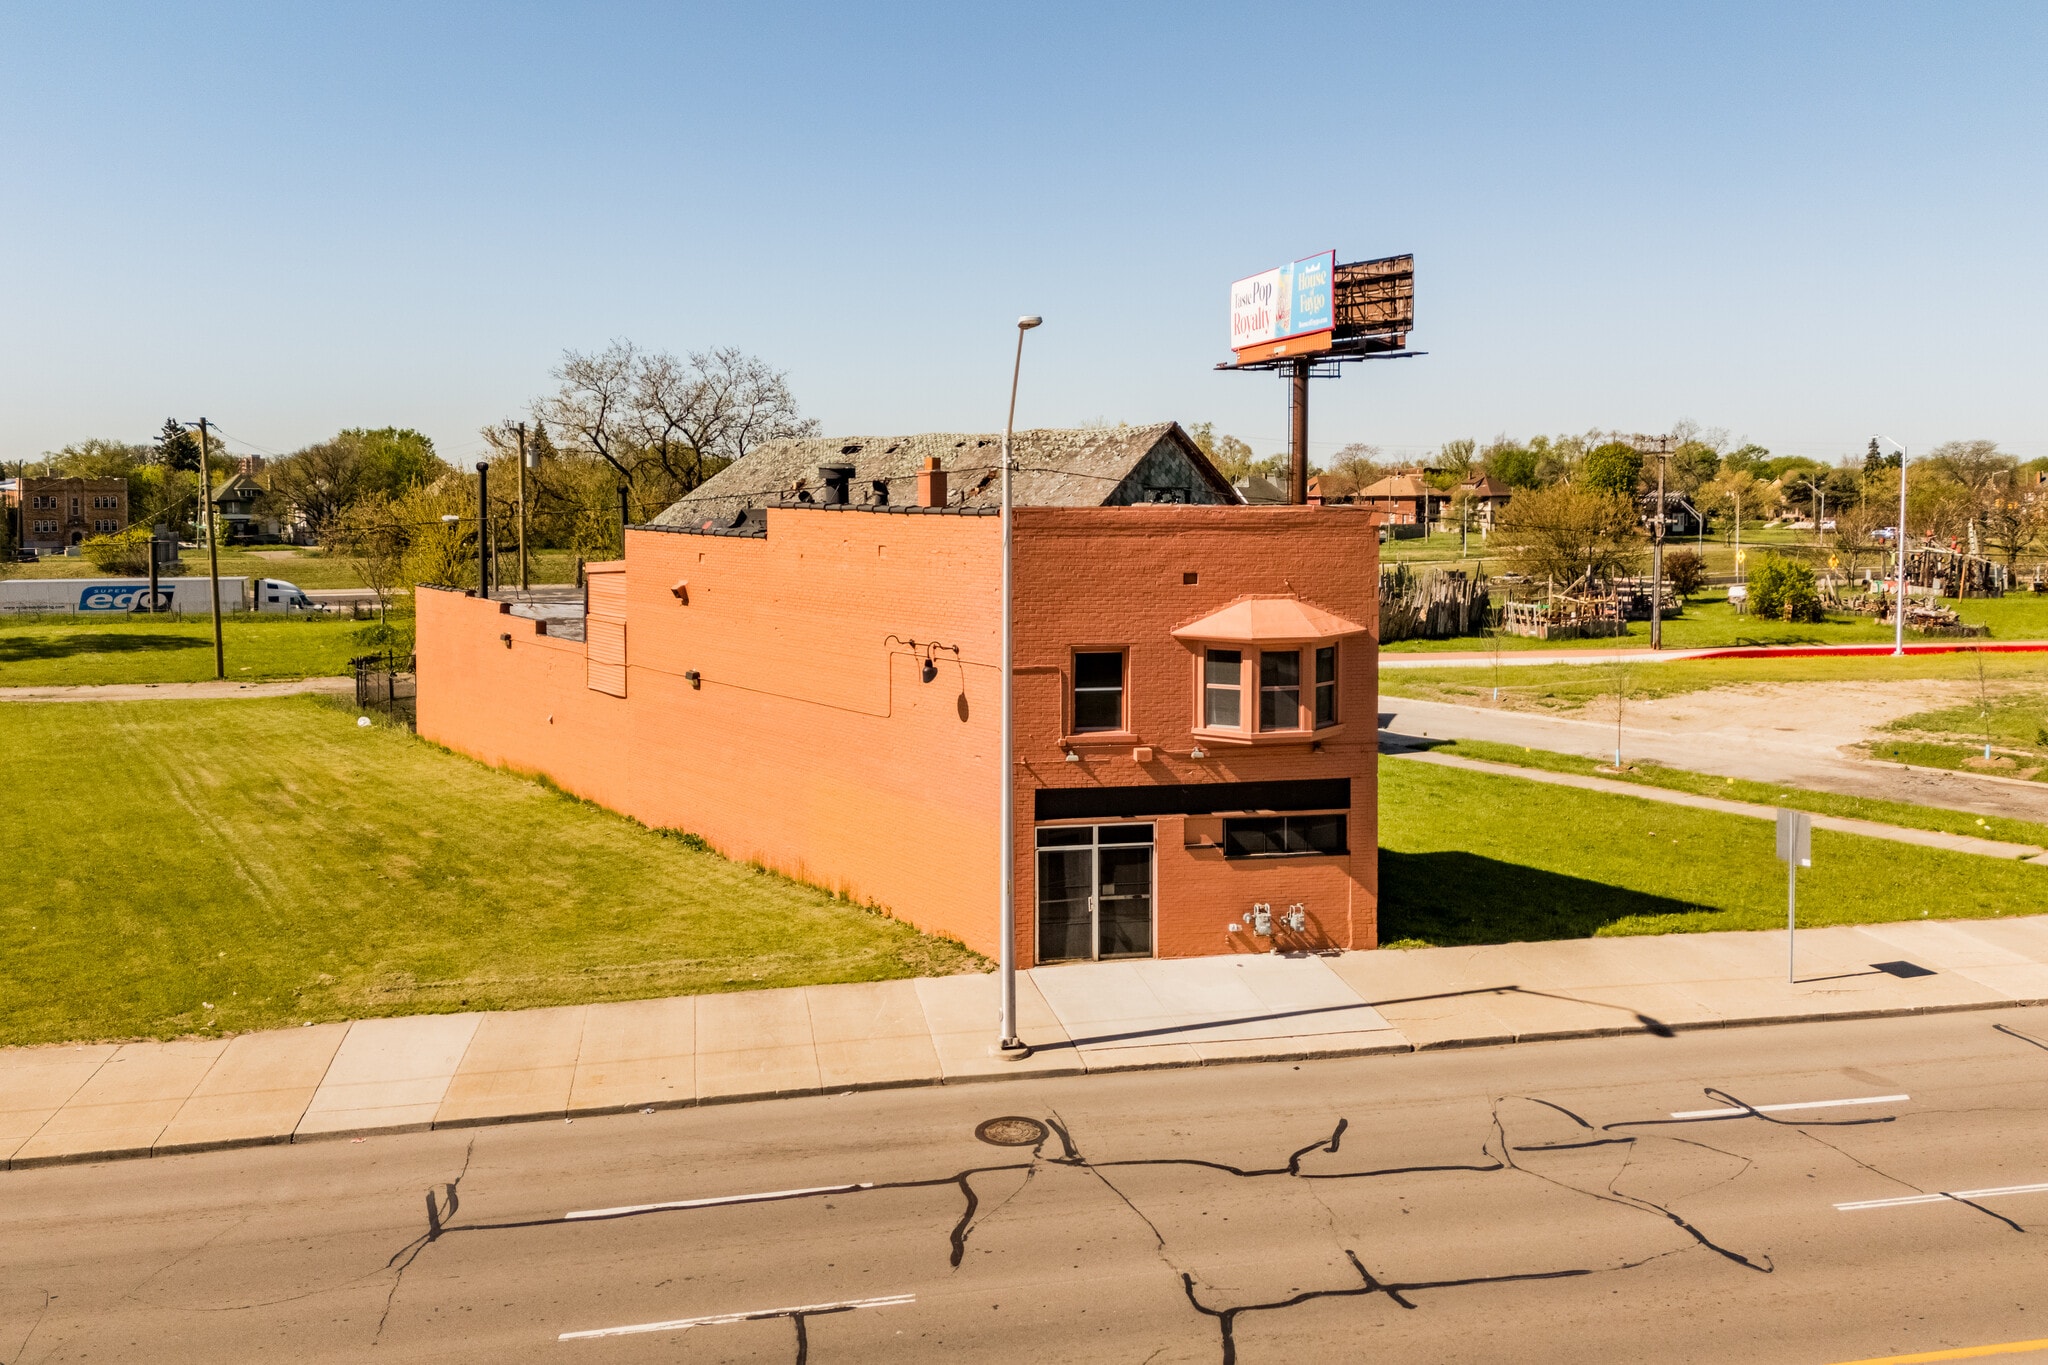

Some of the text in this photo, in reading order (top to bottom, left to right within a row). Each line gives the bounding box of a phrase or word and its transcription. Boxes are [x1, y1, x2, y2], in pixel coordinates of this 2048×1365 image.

[1298, 271, 1326, 290] House
[1235, 281, 1272, 308] Taste Pop
[1300, 294, 1325, 315] Faygo
[1234, 307, 1270, 338] Royalty
